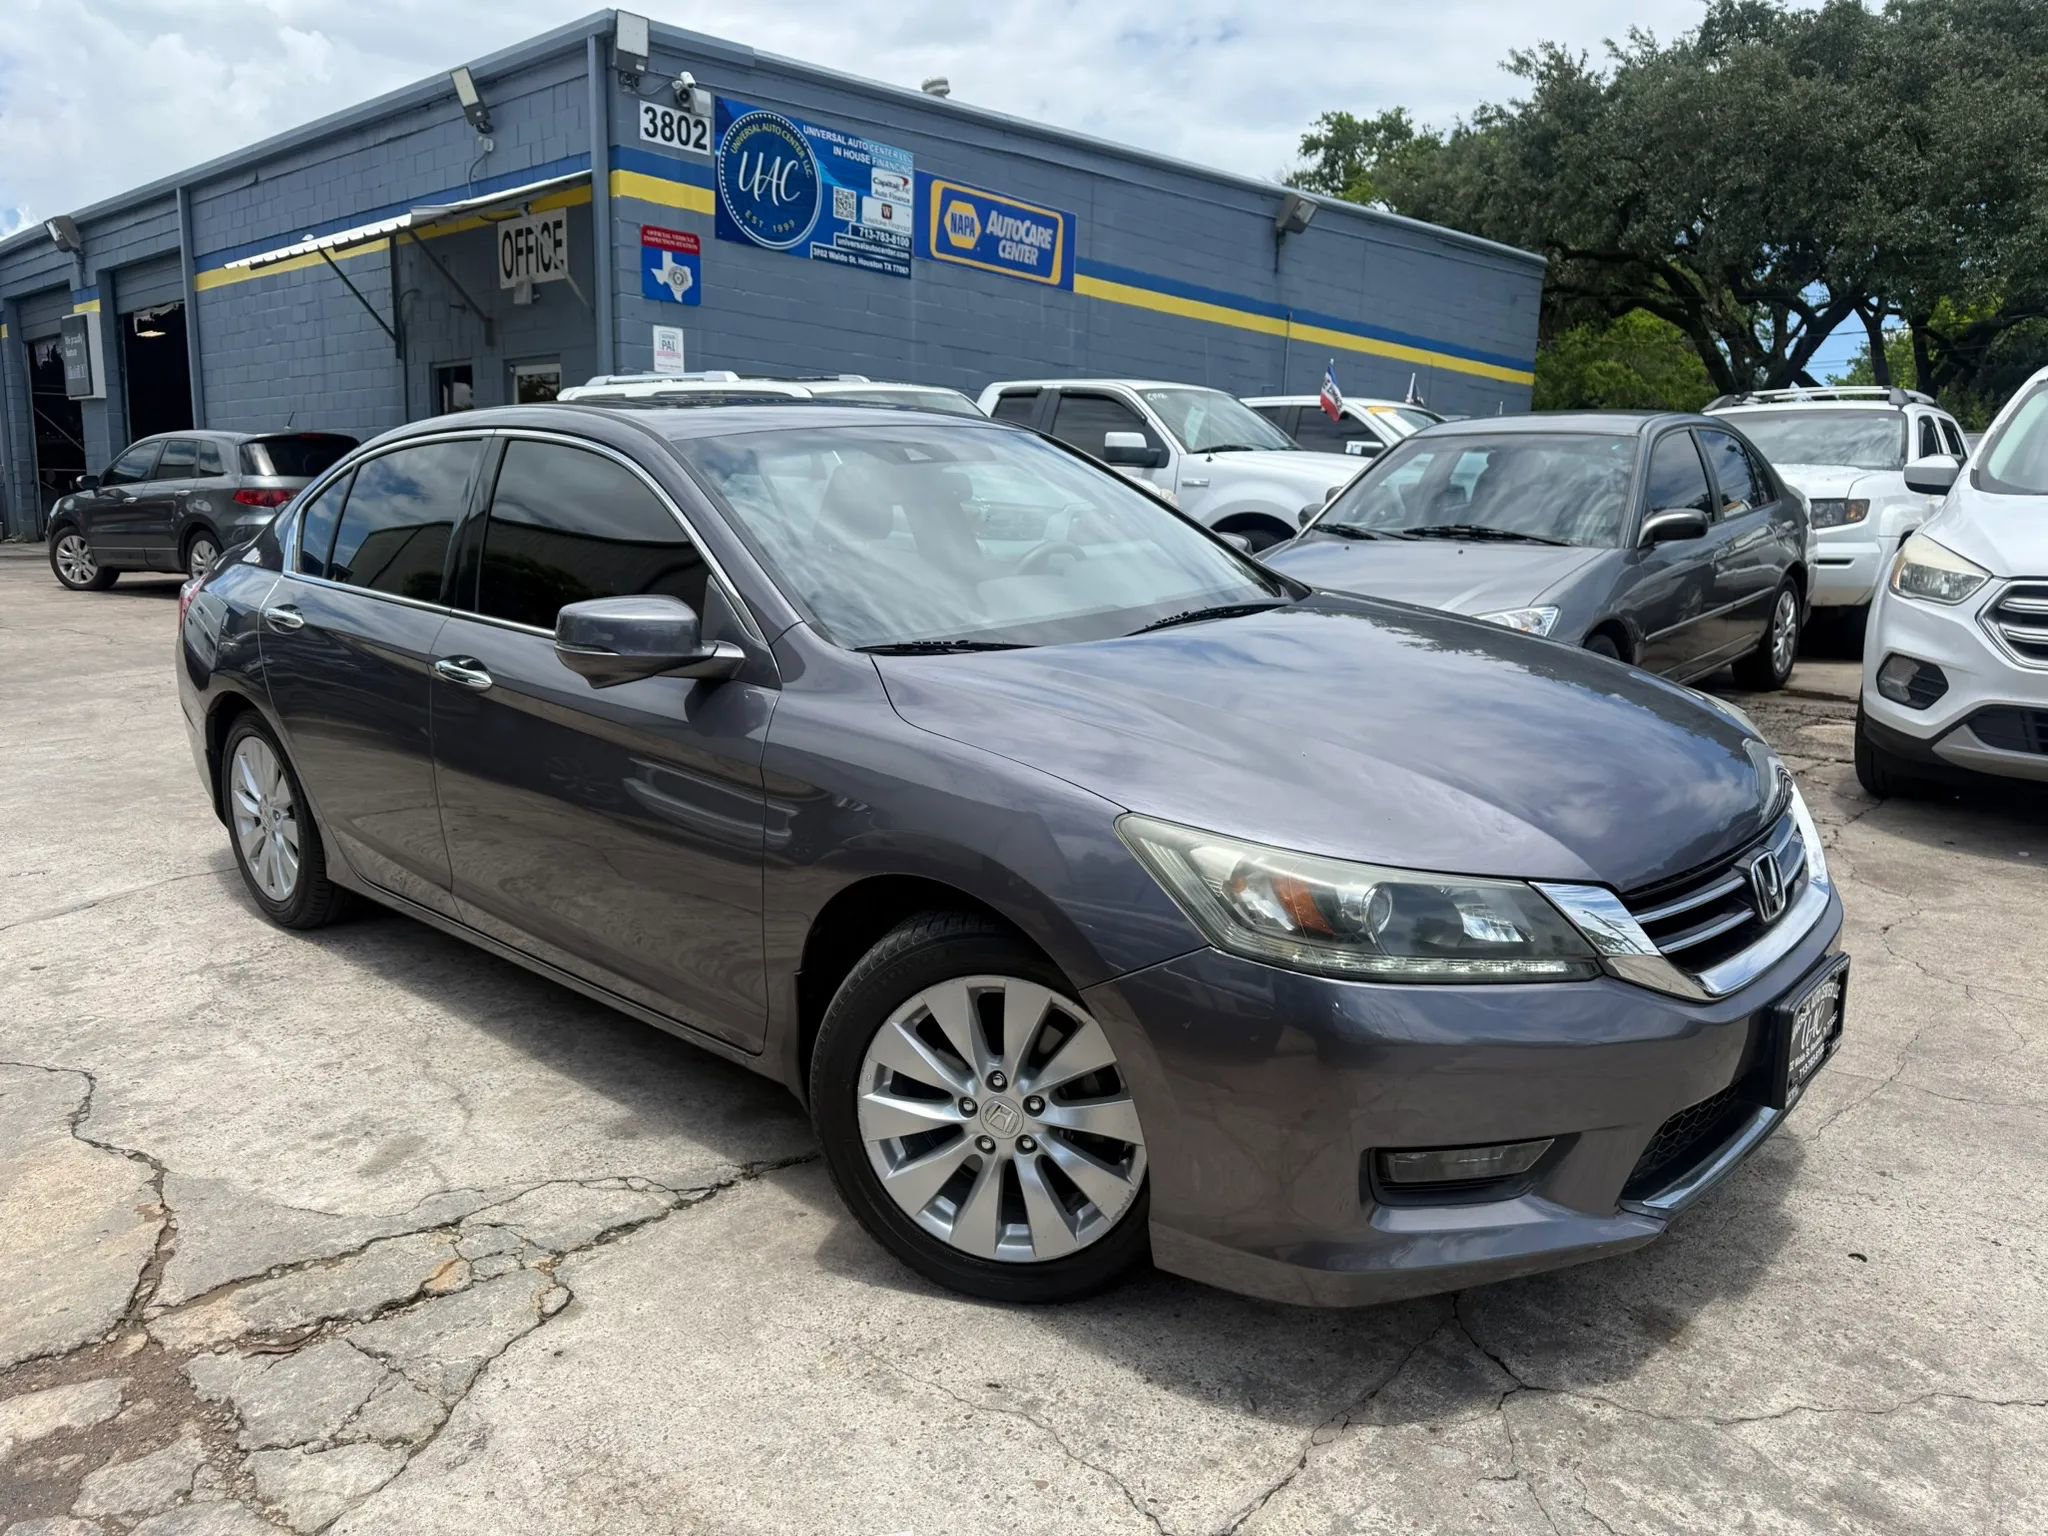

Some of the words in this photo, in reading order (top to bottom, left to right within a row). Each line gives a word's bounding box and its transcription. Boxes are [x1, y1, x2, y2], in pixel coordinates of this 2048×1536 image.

[643, 105, 707, 151] 3802
[730, 123, 761, 154] UNIVERSAL
[761, 123, 781, 136] AUTO
[780, 129, 805, 159] CENTER
[802, 124, 847, 146] UNIVERSAL
[847, 137, 869, 151] AUTO
[868, 143, 898, 158] CENTER
[832, 146, 842, 156] IN
[842, 149, 871, 165] HOUSE
[871, 156, 913, 176] FINANCING
[738, 151, 801, 206] UAC
[772, 219, 796, 233] 1999
[858, 226, 910, 247] 713-783-8100
[950, 212, 976, 239] NAPA
[502, 219, 564, 279] OFFICE
[836, 237, 910, 259] universalautocenter.com
[997, 239, 1039, 266] CENTER
[857, 257, 884, 270] Houston
[883, 262, 892, 271] TX
